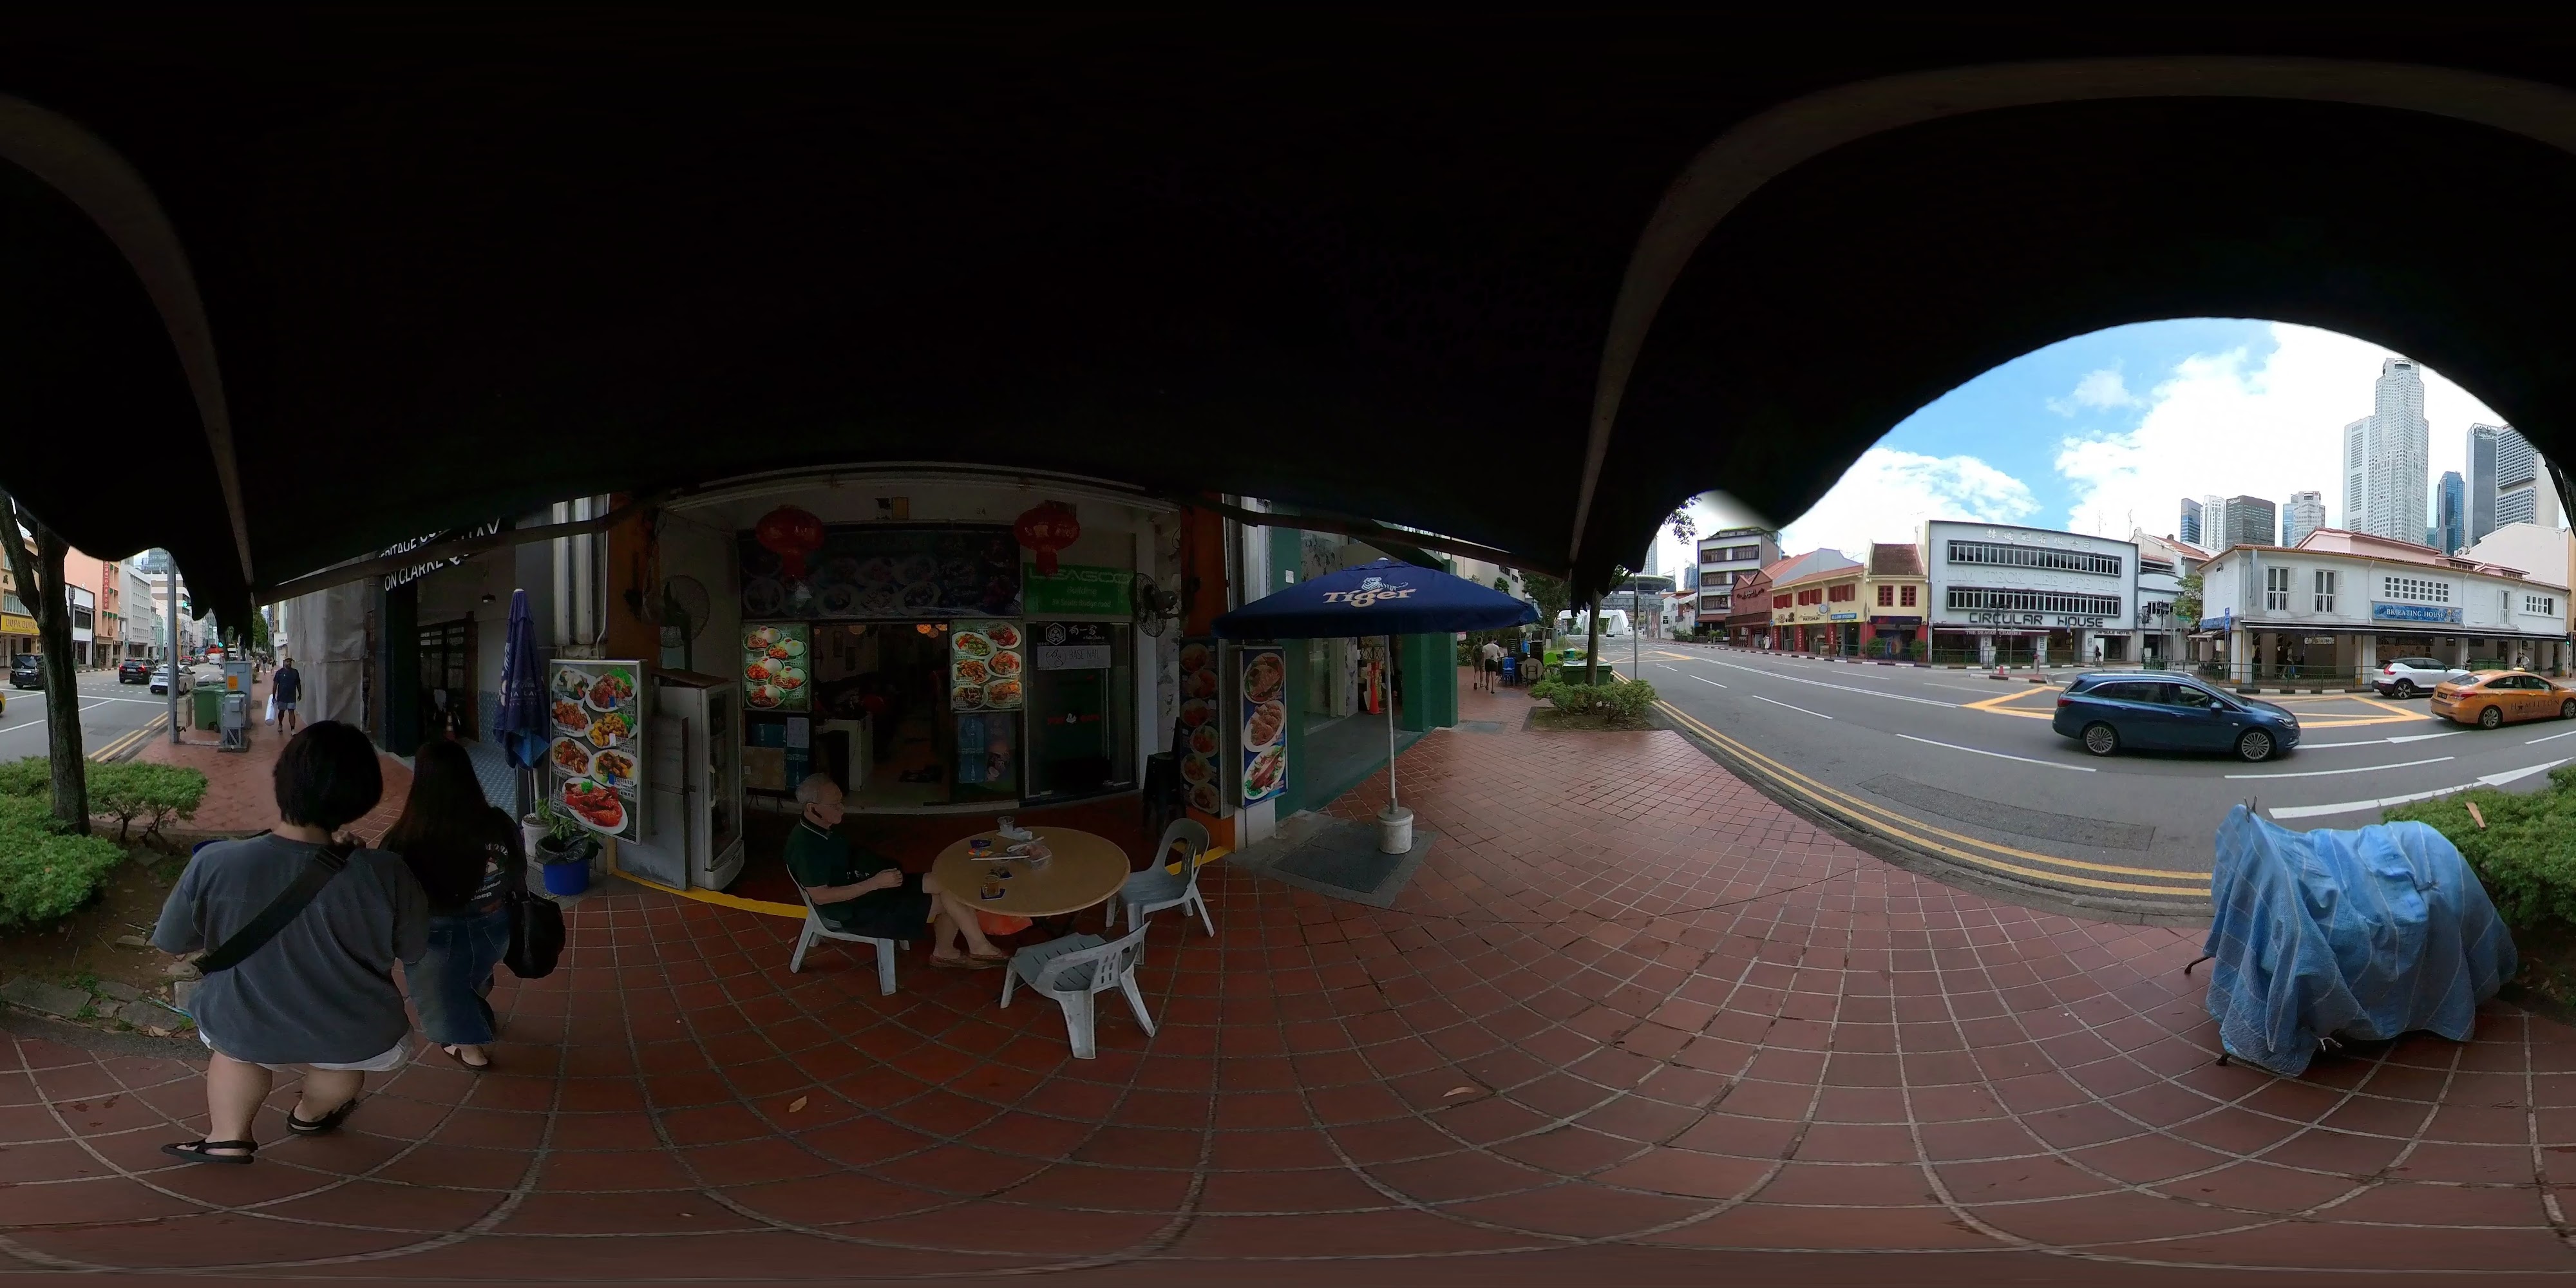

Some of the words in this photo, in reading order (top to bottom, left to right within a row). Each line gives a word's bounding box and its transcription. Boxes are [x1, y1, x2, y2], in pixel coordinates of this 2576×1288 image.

[385, 574, 397, 592] ON
[1947, 569, 1976, 582] LIM
[1984, 570, 2025, 584] TECK
[2033, 573, 2059, 587] LEE
[2065, 576, 2092, 589] PTE
[2097, 578, 2120, 592] LTD
[1322, 588, 1417, 608] Tiger
[1969, 612, 2043, 625] CIRCULAR
[2057, 615, 2104, 628] HOUSE
[2398, 609, 2421, 618] EATING
[1069, 649, 1084, 659] BASE
[1086, 649, 1101, 659] NAIL
